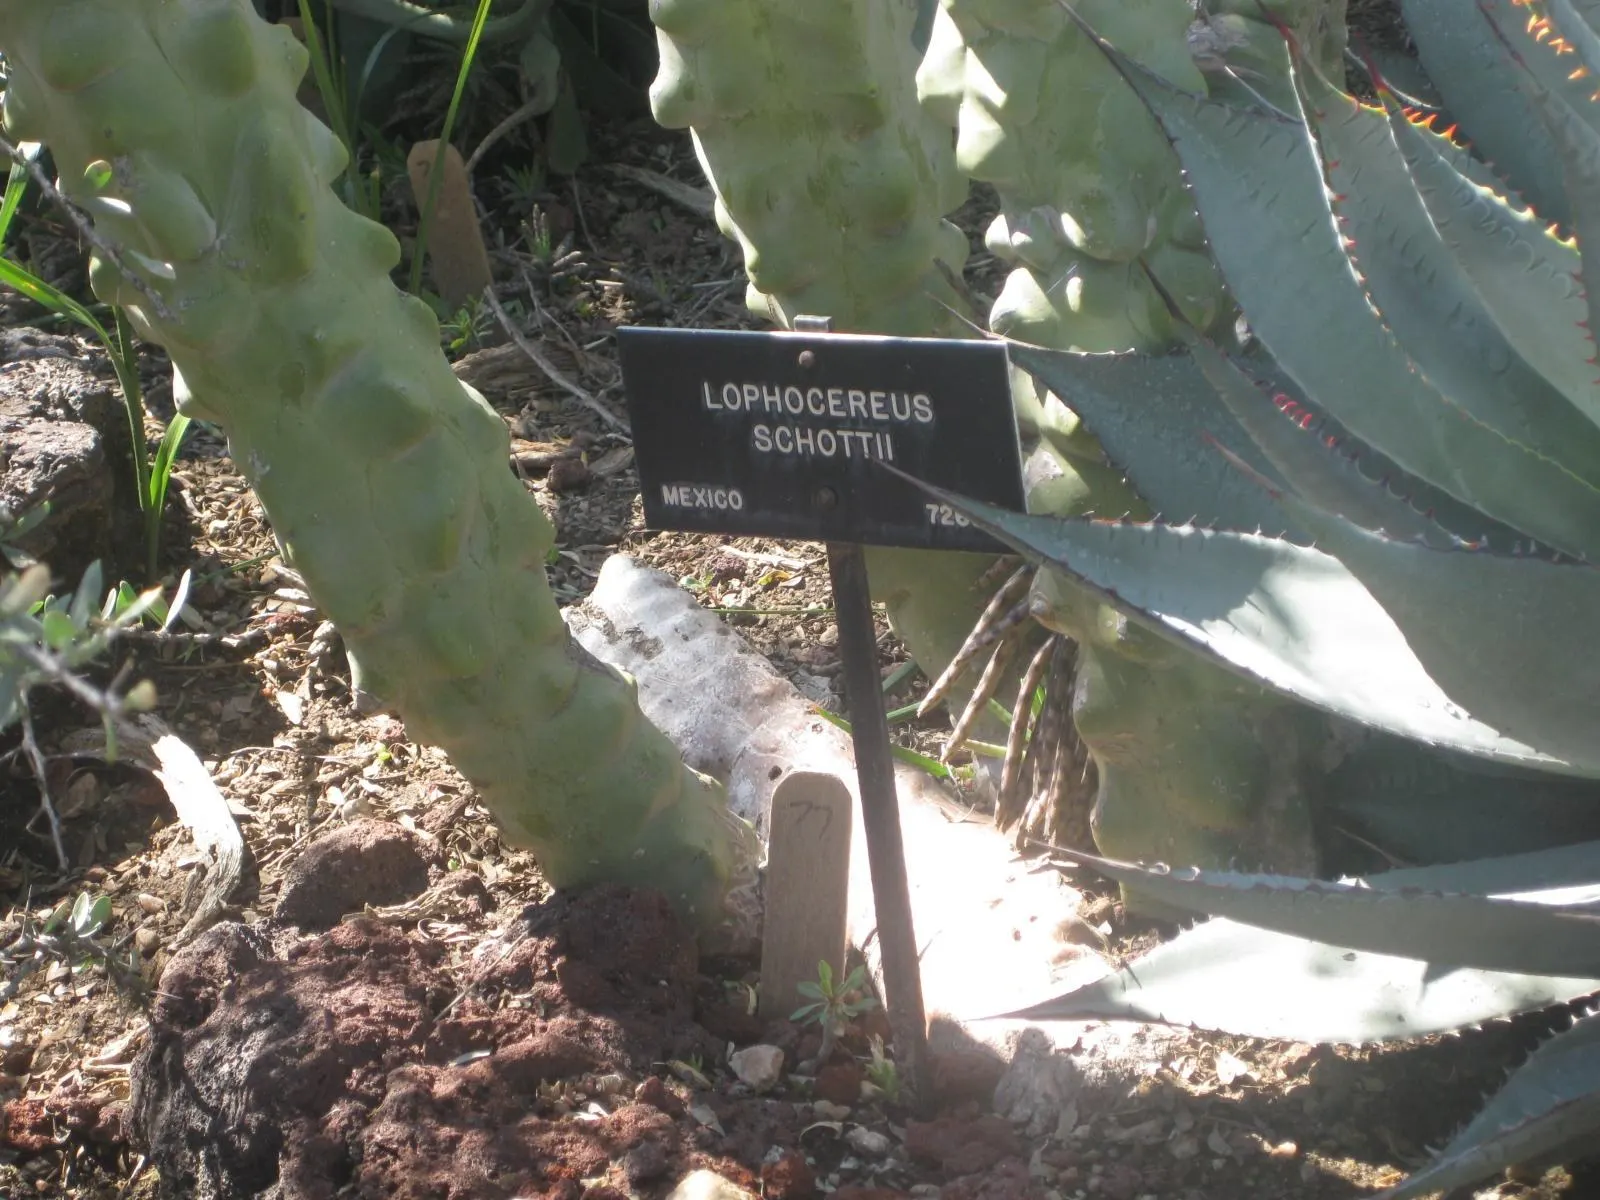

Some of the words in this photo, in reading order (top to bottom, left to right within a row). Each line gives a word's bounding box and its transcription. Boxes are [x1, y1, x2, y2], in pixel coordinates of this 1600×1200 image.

[703, 381, 934, 423] LOPHOCEREUS
[753, 424, 893, 461] SCHOTTII
[661, 484, 743, 510] MEXICO
[925, 503, 979, 528] 726
